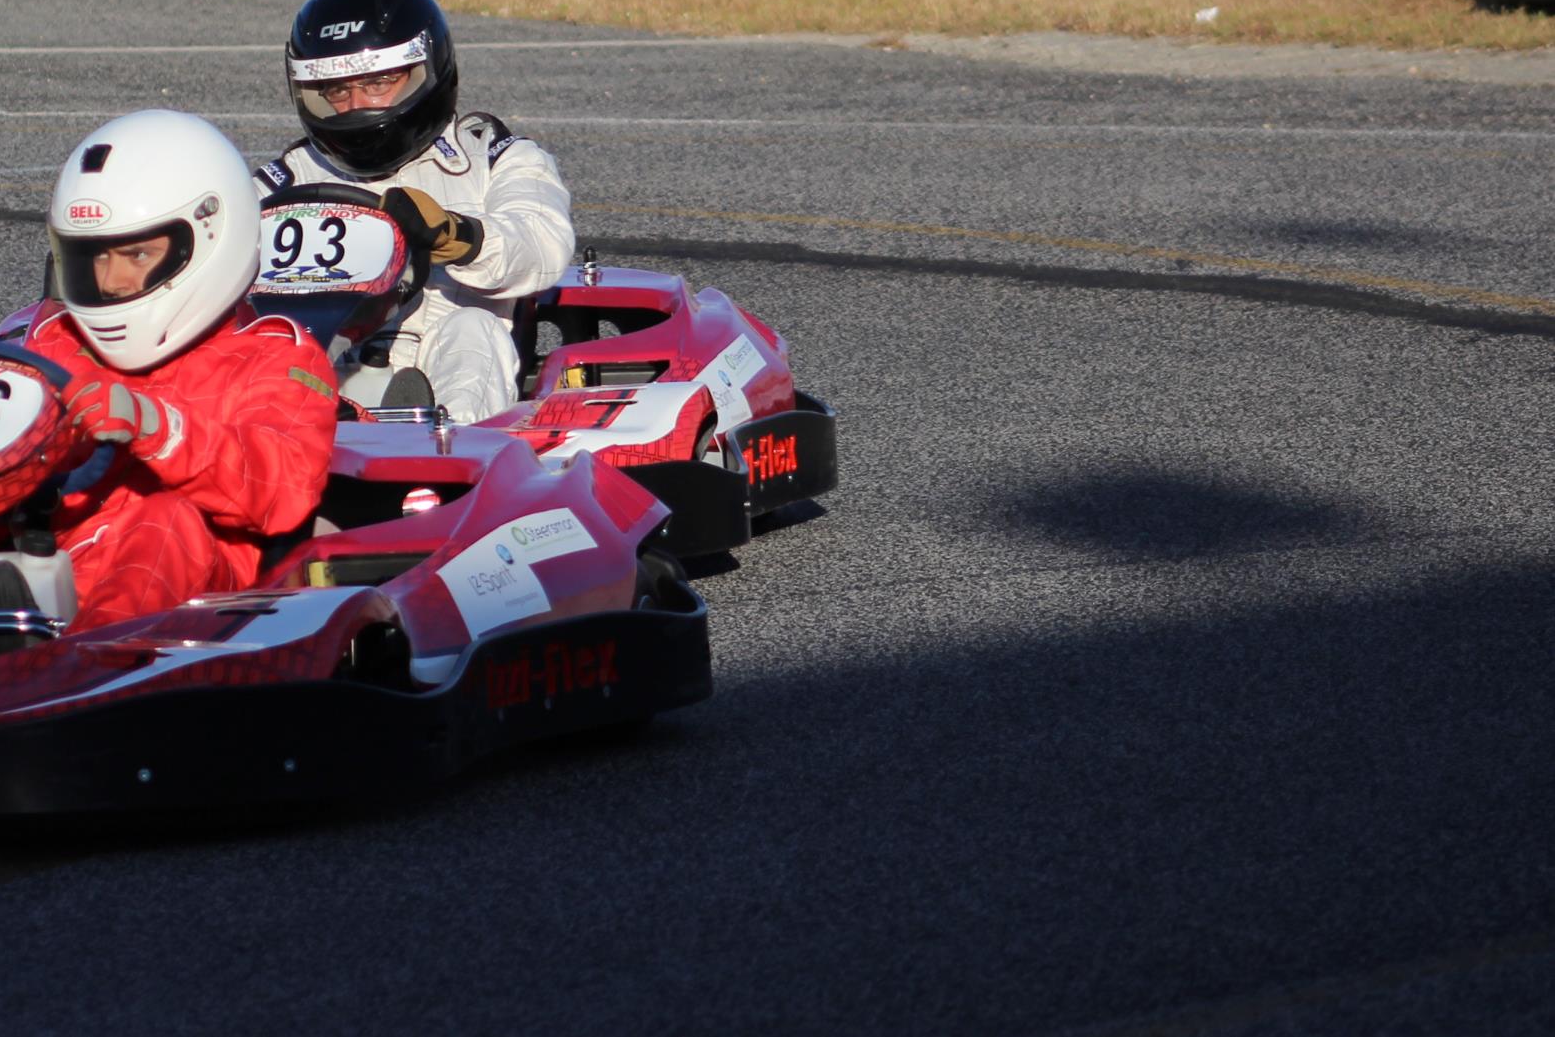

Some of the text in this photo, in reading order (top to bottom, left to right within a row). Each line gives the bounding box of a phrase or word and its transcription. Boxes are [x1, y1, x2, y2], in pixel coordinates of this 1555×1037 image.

[320, 20, 366, 41] agv
[69, 205, 104, 219] BELL
[274, 207, 362, 222] EUROINDY
[270, 217, 347, 269] 93
